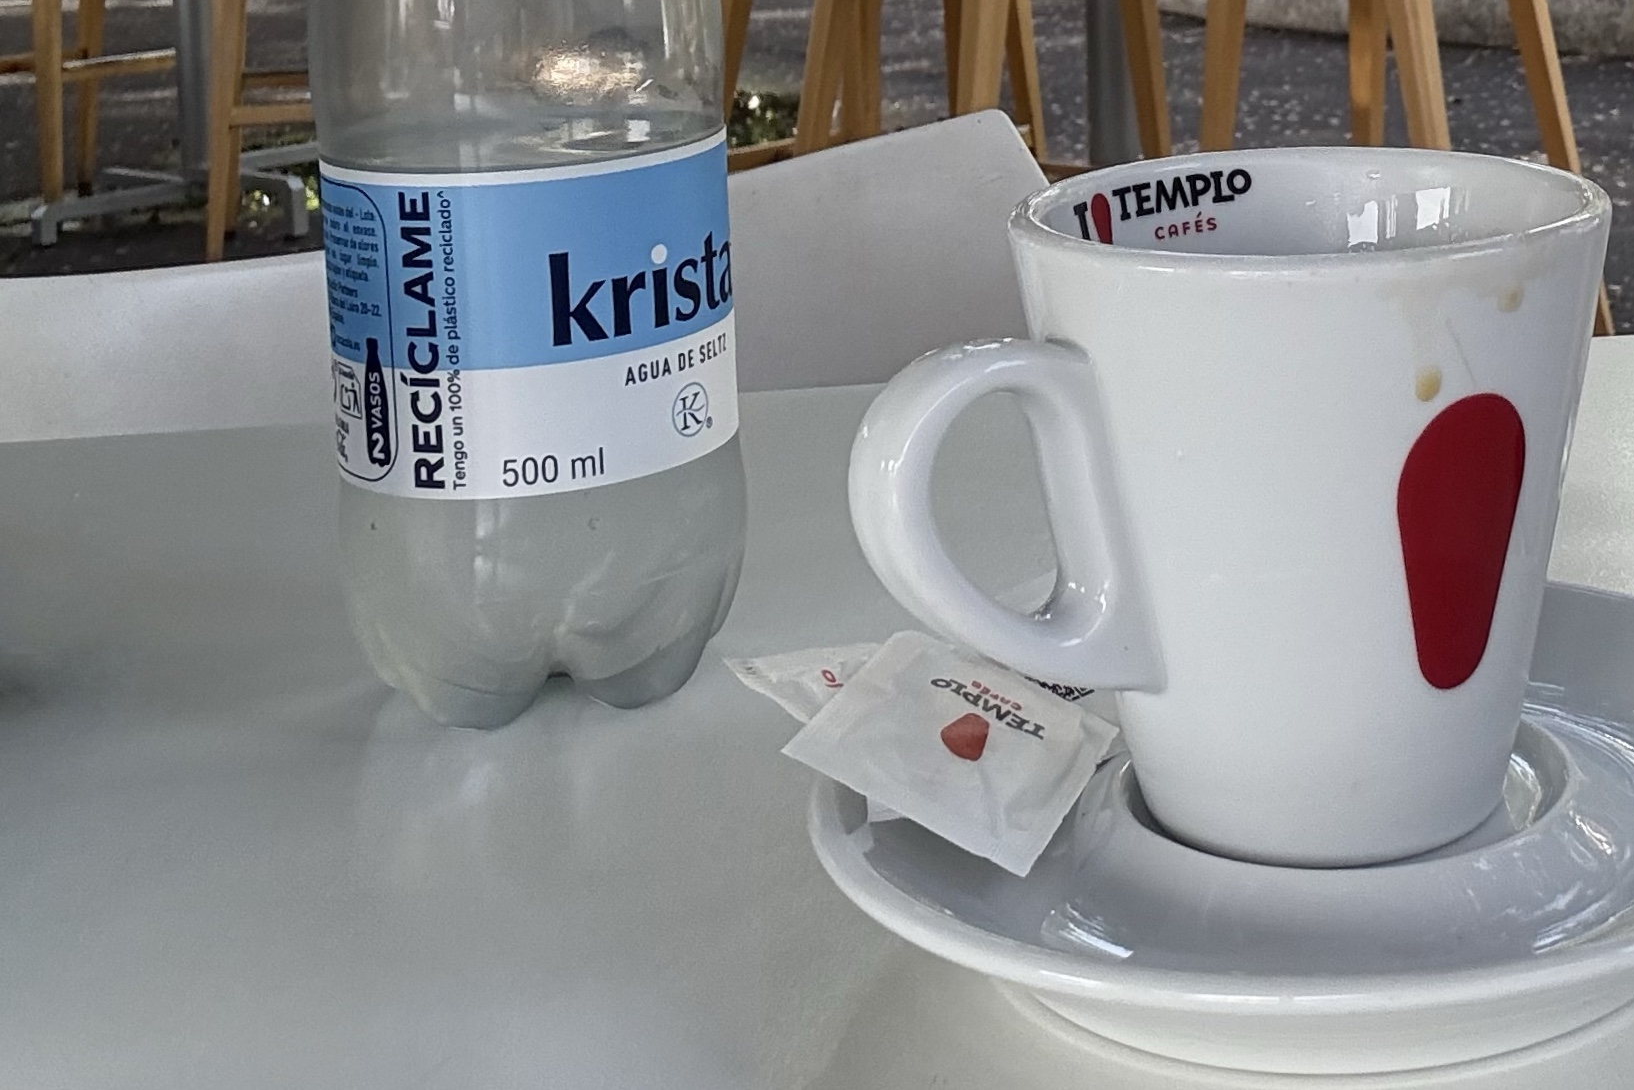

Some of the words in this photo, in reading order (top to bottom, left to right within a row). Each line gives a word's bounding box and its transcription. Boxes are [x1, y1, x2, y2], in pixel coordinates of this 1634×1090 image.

[1111, 169, 1252, 222] TEMPLO
[1154, 212, 1218, 240] CAFÉS
[442, 276, 461, 340] plástico
[398, 191, 446, 490] RECÍCLAME
[446, 344, 460, 365] de
[625, 357, 672, 387] AGUA
[678, 349, 695, 372] DE
[700, 333, 727, 364] SELTZ
[368, 372, 383, 428] VASOS
[447, 369, 462, 412] 100%
[372, 432, 385, 460] 2
[453, 416, 463, 436] un
[453, 440, 468, 491] Tengo
[502, 454, 559, 488] 500
[570, 447, 605, 480] ml
[931, 678, 1045, 741] TEMPLO
